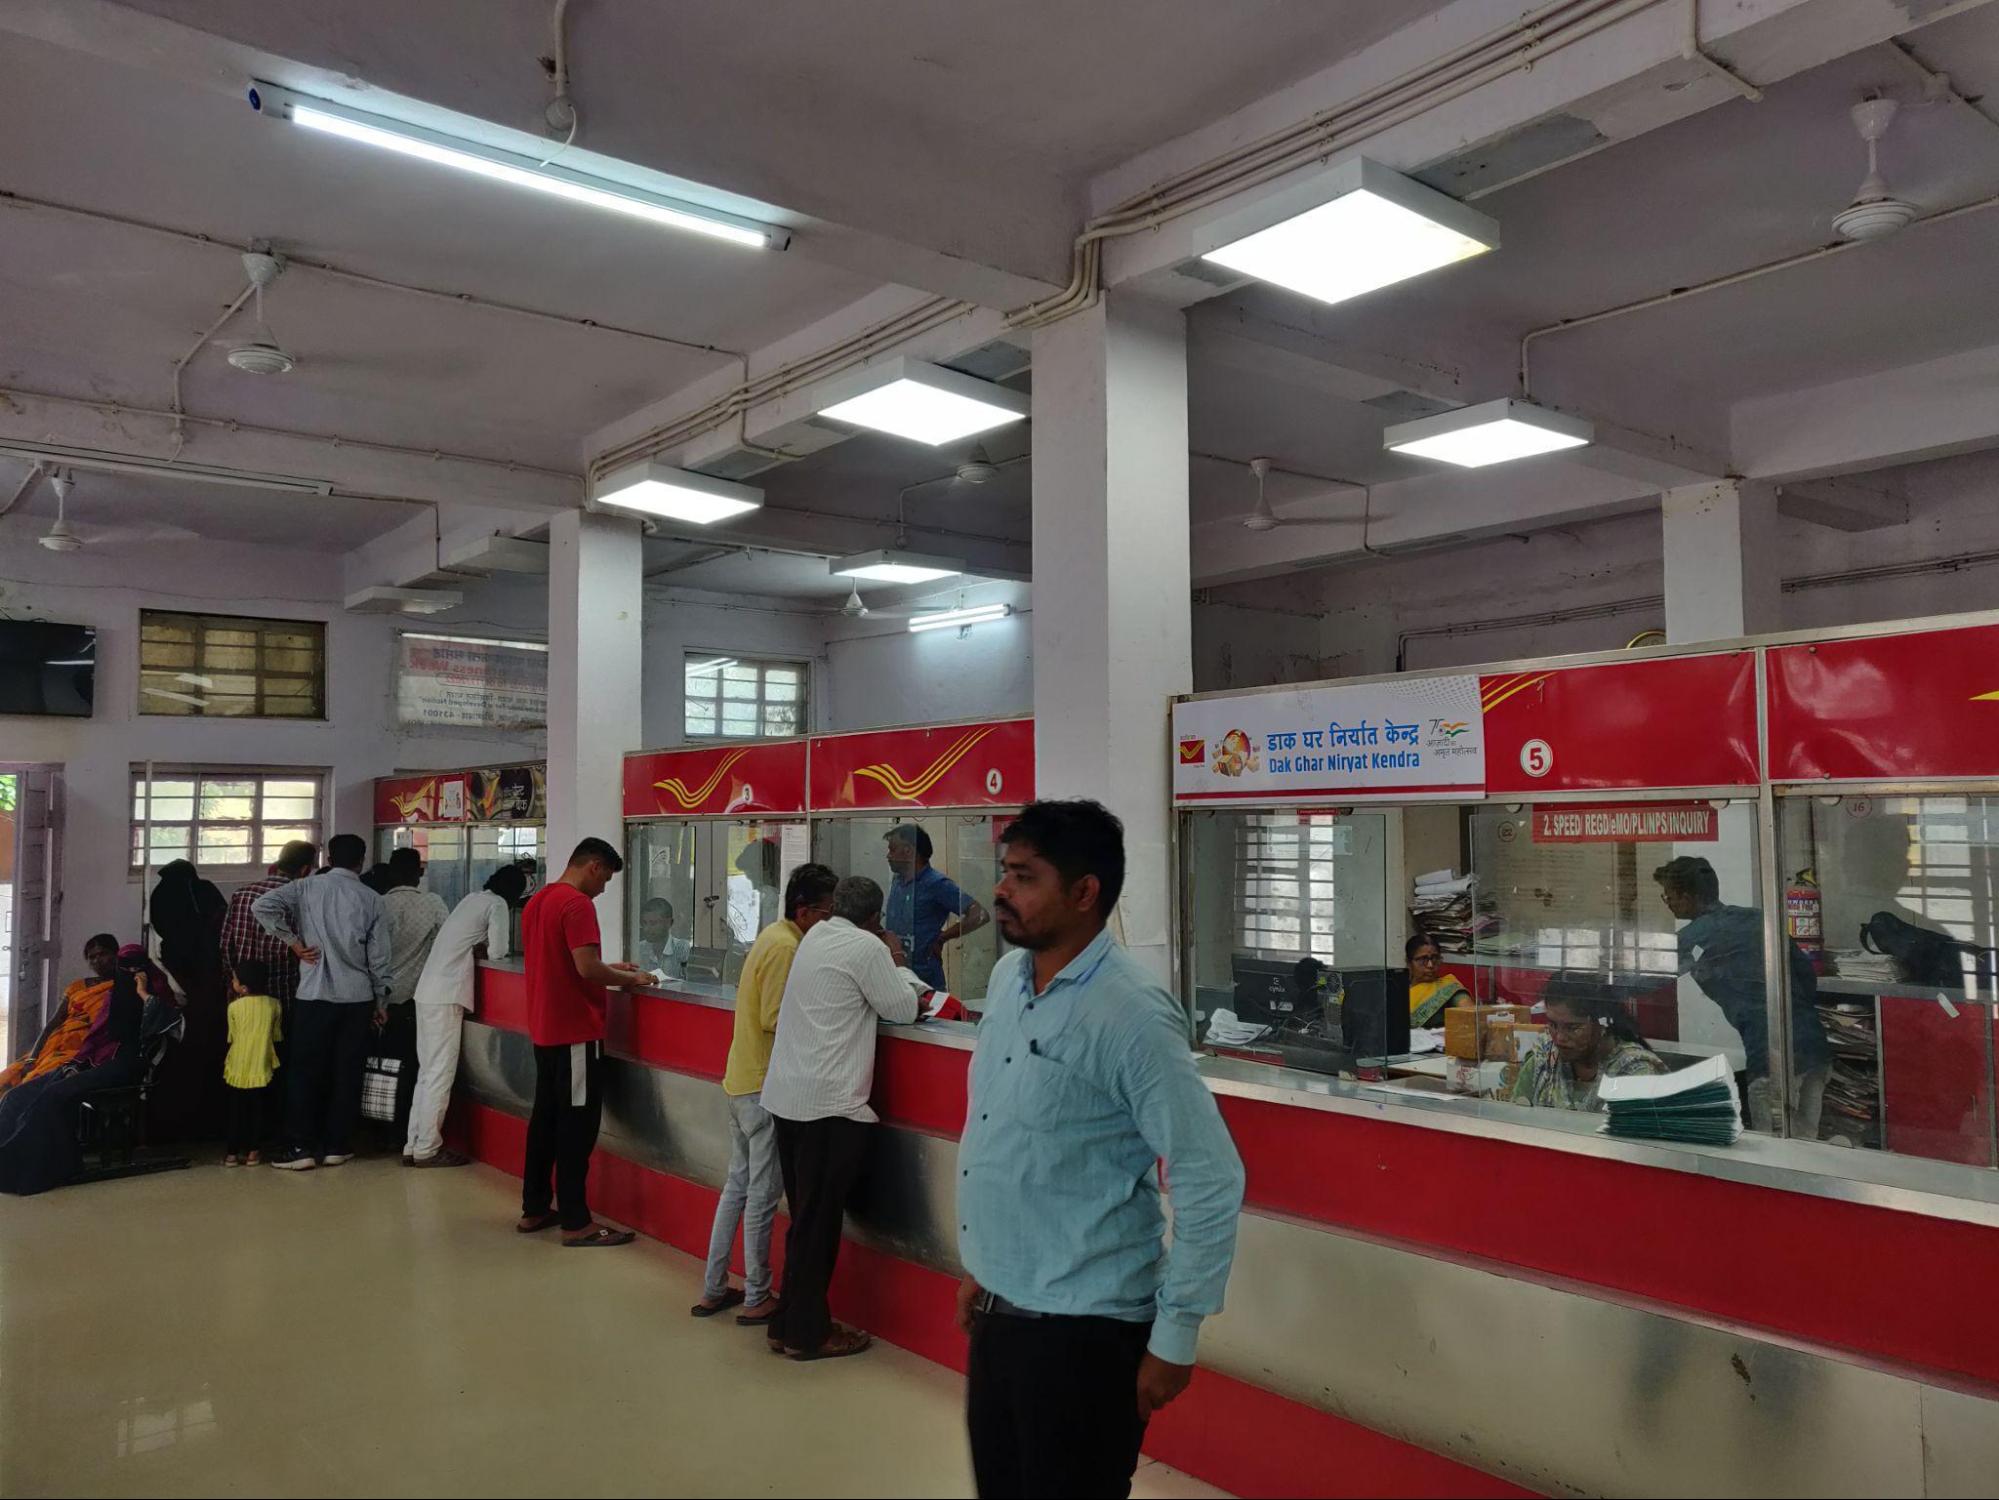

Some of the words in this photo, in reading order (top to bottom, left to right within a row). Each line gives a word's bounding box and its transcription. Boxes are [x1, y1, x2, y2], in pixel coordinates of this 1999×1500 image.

[1267, 732, 1297, 751] डाक
[1302, 731, 1323, 749] घर
[1329, 720, 1378, 747] निर्यात
[1384, 719, 1419, 745] केन्द्र
[1269, 756, 1292, 773] Dak
[1295, 755, 1324, 772] Ghar
[1328, 754, 1368, 773] Niryat
[1372, 751, 1420, 769] Kendra
[1529, 747, 1544, 771] 5
[990, 773, 998, 789] 4
[744, 788, 750, 801] 3
